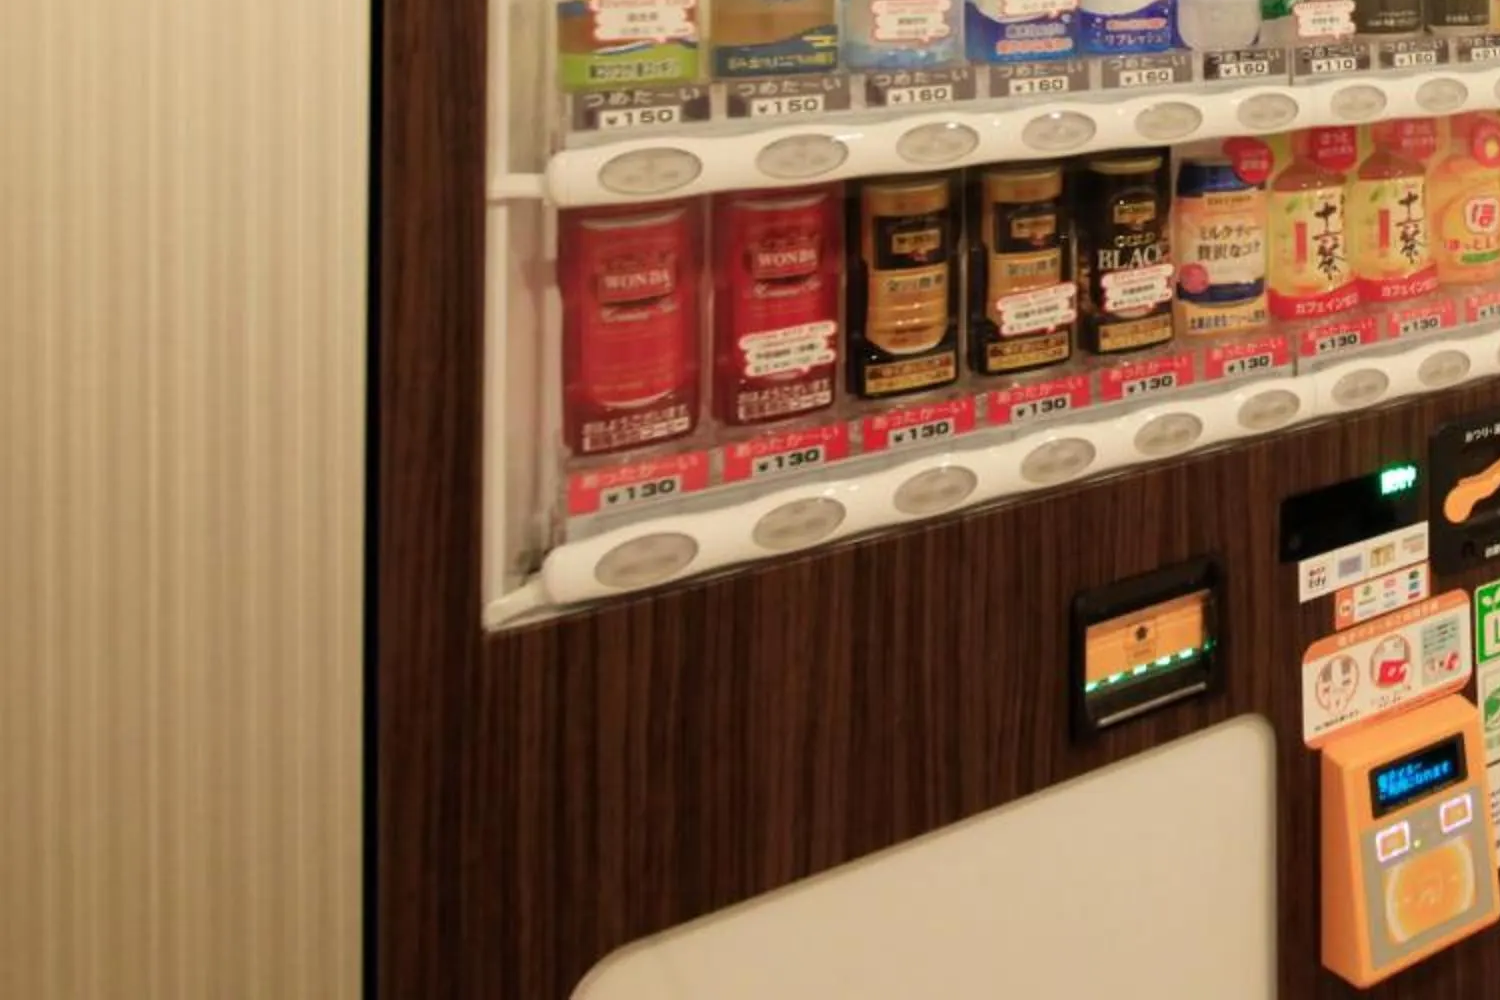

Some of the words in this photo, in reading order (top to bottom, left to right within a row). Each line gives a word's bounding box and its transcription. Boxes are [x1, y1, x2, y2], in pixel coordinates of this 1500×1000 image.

[757, 97, 819, 115] ¥150
[605, 108, 675, 127] ¥150
[1015, 396, 1067, 418] ¥130
[892, 422, 949, 444] ¥130
[758, 448, 820, 472] ¥130
[606, 478, 676, 505] ¥130
